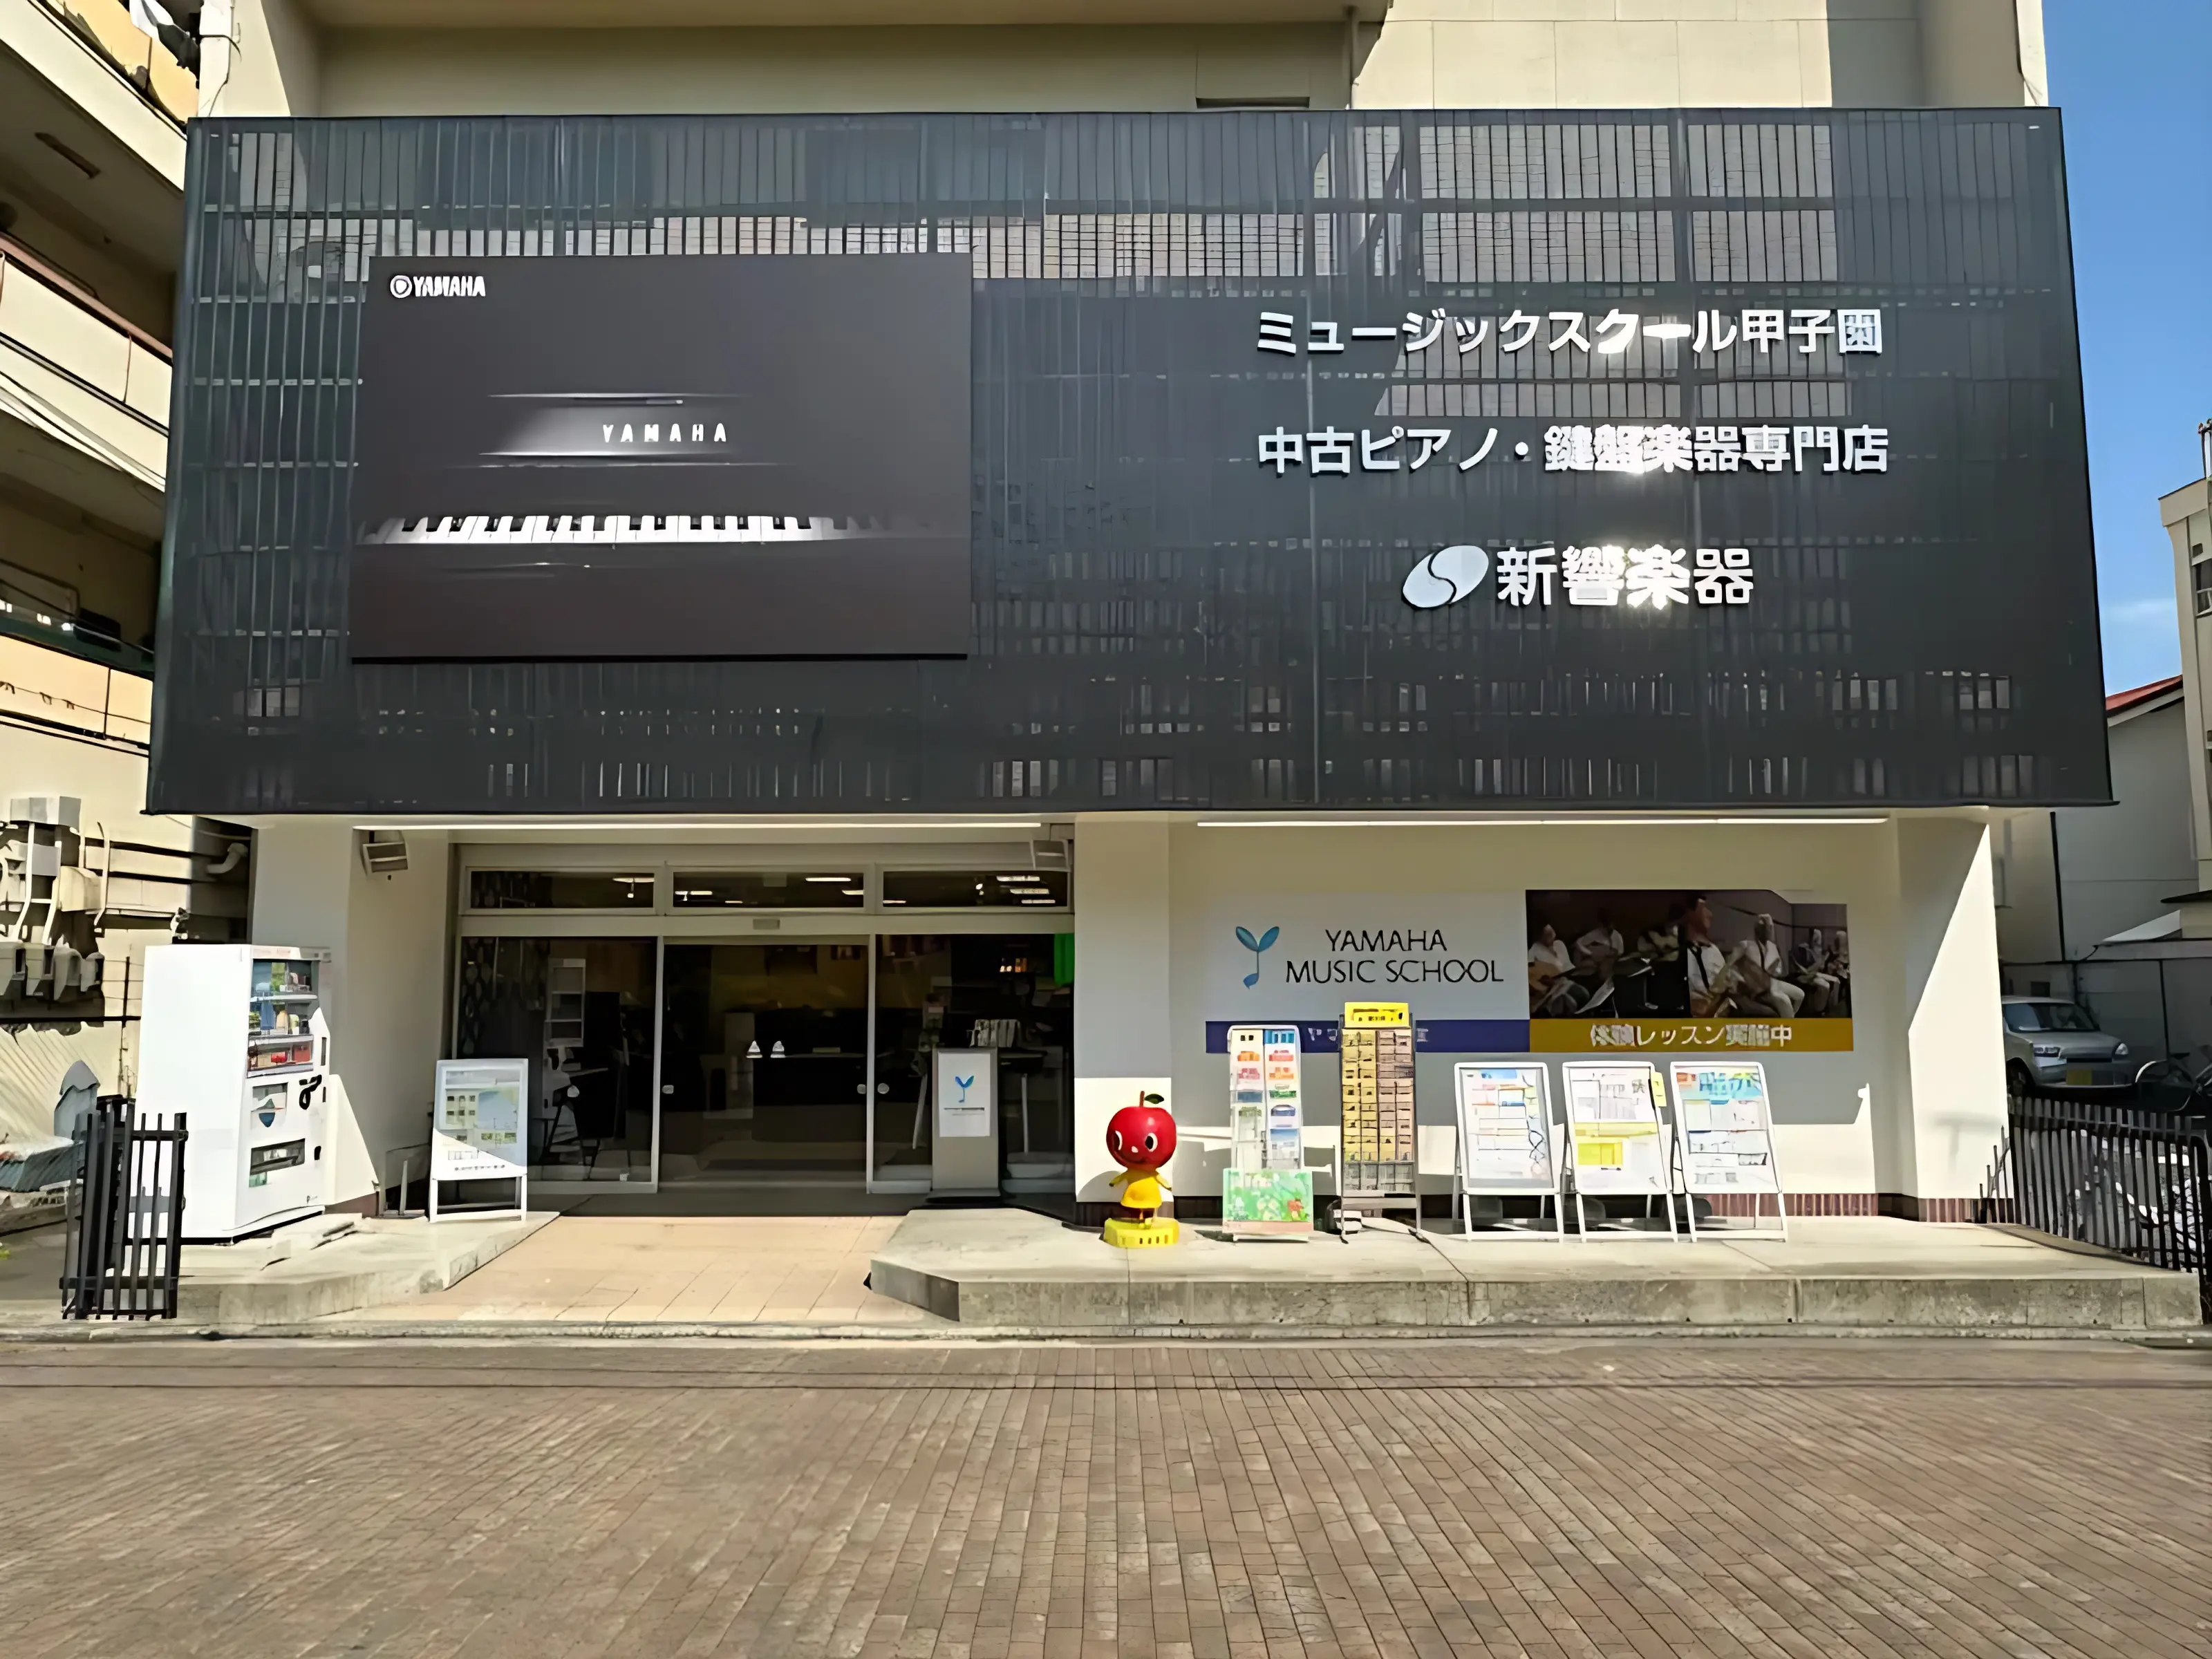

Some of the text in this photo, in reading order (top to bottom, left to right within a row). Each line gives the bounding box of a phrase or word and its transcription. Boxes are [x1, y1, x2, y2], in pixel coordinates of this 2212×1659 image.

[413, 276, 486, 297] YAMAHA
[1257, 308, 1882, 355] ミュージックスクール甲子園
[603, 423, 727, 442] YAMAHA
[1258, 424, 1888, 475] 中古ピアノ・鍵盤楽器専門店
[1497, 545, 1754, 609] 新響楽器
[1325, 929, 1447, 952] YAMAHA
[1286, 959, 1504, 984] MUSIC SCHOOL
